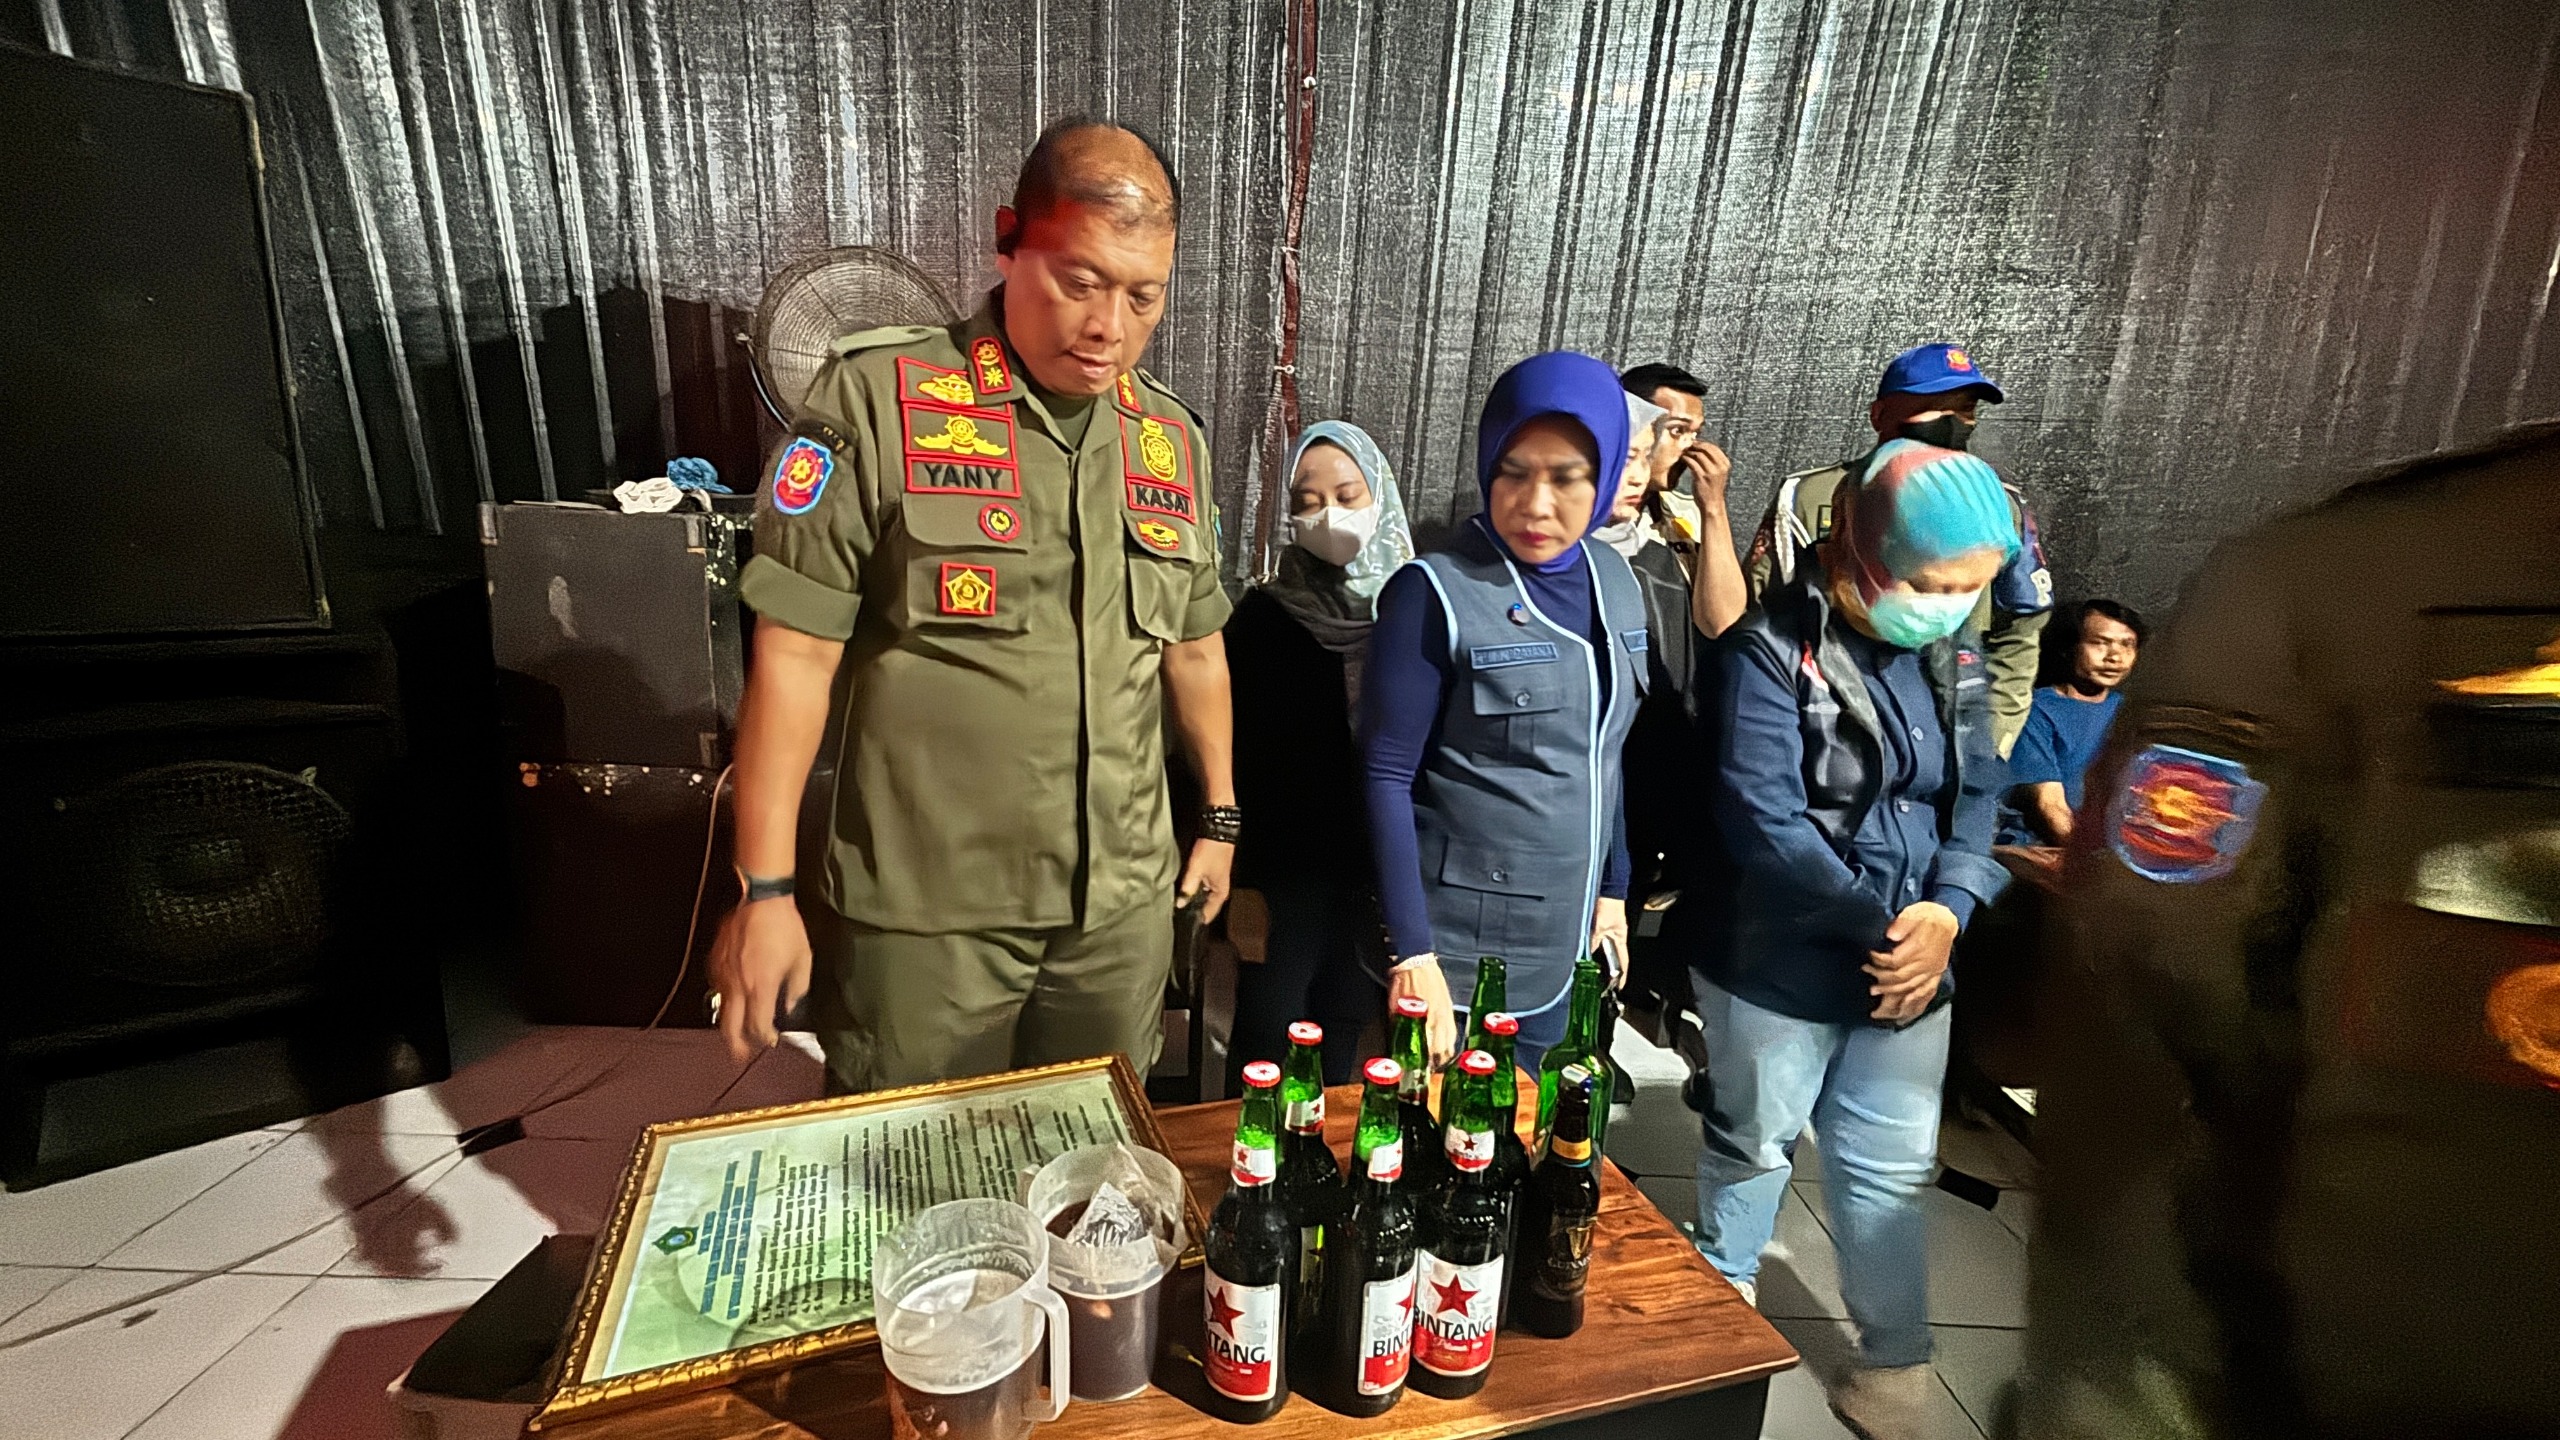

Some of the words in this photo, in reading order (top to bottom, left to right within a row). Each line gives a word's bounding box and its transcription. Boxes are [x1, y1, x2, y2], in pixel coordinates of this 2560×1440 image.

[924, 463, 1003, 490] YANY
[1373, 1323, 1411, 1358] BINT
[1413, 1304, 1493, 1342] BINTANG
[1205, 1329, 1265, 1364] TANG
